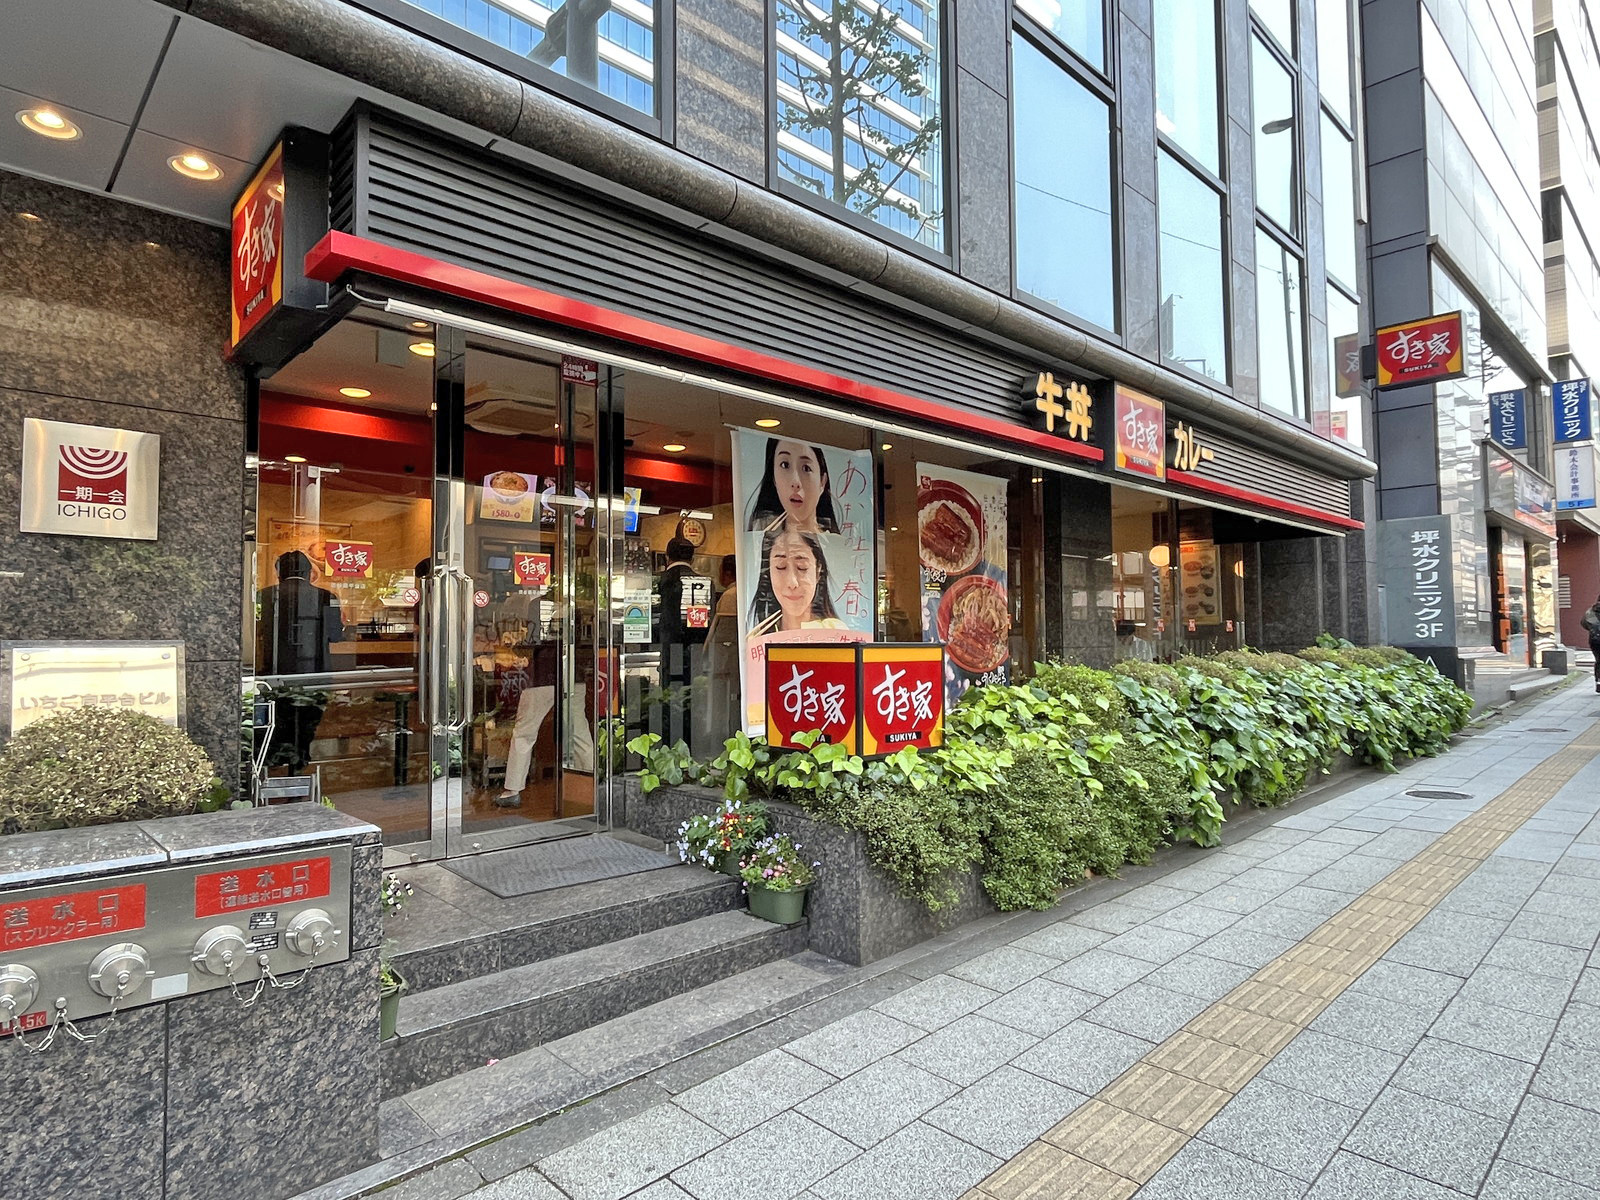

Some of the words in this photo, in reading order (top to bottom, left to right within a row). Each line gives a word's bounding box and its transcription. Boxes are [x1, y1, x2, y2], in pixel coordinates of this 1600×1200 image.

[237, 199, 276, 292] すき家
[1386, 330, 1451, 363] すき家
[1403, 363, 1433, 373] SUKIYA
[1036, 371, 1093, 442] 牛丼
[1561, 381, 1582, 439] 坪水クリニック
[1122, 400, 1159, 457] すき家
[1173, 420, 1215, 471] カレー
[57, 504, 127, 521] ICHIGO
[60, 486, 125, 504] 一期一会
[331, 543, 368, 569] すき家
[519, 555, 547, 578] すき家
[1410, 529, 1443, 621] 坪水クリニック
[1415, 622, 1444, 638] 3F
[778, 664, 846, 732] すき家
[872, 664, 934, 730] すき家
[889, 732, 918, 743] SUKIYA
